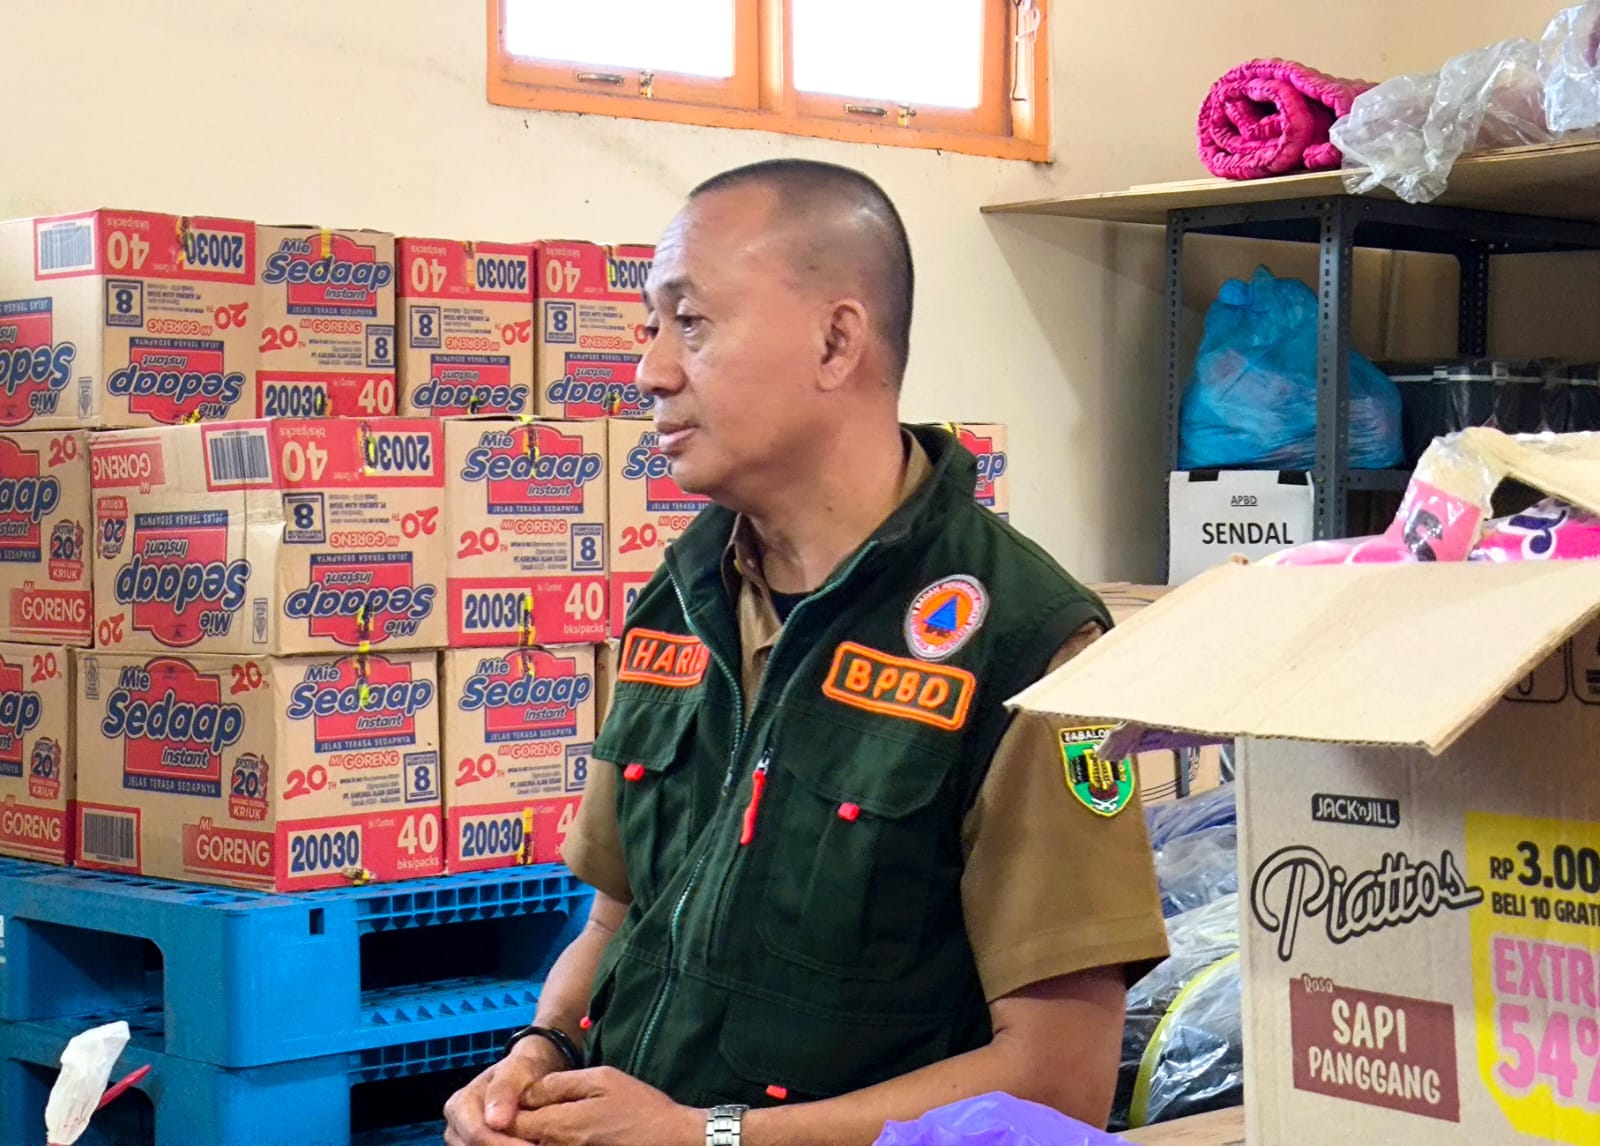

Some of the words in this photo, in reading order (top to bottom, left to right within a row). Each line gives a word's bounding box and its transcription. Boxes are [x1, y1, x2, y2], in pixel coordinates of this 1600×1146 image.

[108, 230, 150, 270] 40
[185, 232, 243, 268] 20030
[280, 239, 311, 256] Mie
[262, 253, 392, 292] Sedaap
[411, 257, 448, 293] 40
[476, 258, 526, 290] 20030
[546, 260, 581, 294] 40
[115, 290, 133, 314] 8
[325, 287, 368, 300] Instant
[147, 318, 200, 335] GORENG
[312, 319, 362, 334] GORENG
[418, 314, 434, 336] 8
[554, 310, 568, 332] 8
[258, 324, 298, 353] 20
[374, 336, 388, 360] 8
[445, 336, 488, 350] GORENG
[580, 336, 622, 350] GORENG
[142, 355, 188, 366] Instant
[106, 362, 245, 404] Sedaap
[441, 370, 479, 381] Instant
[576, 368, 612, 379] Instant
[28, 390, 60, 415] Mie
[264, 384, 326, 417] 20030
[358, 379, 394, 415] 40
[412, 378, 529, 413] Sedaap
[198, 402, 230, 419] Mie
[479, 430, 514, 449] Mie
[639, 430, 660, 448] Mi
[282, 441, 328, 482] 40
[368, 434, 430, 472] 20030
[462, 447, 603, 487] Sedaap
[527, 482, 574, 498] Instant
[1231, 495, 1258, 506] APBD
[293, 503, 314, 530] 8
[514, 519, 568, 535] GORENG
[330, 531, 386, 548] GORENG
[458, 526, 500, 559] 20
[619, 523, 657, 554] 20
[1202, 522, 1294, 544] SENDAL
[144, 538, 189, 558] Instant
[580, 536, 596, 562] 8
[52, 568, 78, 581] KRIUK
[114, 554, 251, 614] Sedaap
[324, 571, 374, 586] Instant
[21, 596, 86, 622] GORENG
[284, 581, 436, 619] Sedaap
[564, 582, 604, 621] 40
[199, 610, 232, 636] Mie
[385, 620, 420, 637] Mie
[120, 666, 151, 690] Mie
[303, 664, 340, 682] Mie
[477, 658, 510, 676] Mie
[459, 674, 592, 710] Sedaap
[844, 658, 950, 709] BPBD
[286, 679, 434, 720] Sedaap
[101, 688, 244, 756] Sedaap
[356, 716, 404, 731] Instant
[524, 708, 568, 720] Instant
[320, 741, 344, 751] JELAS
[345, 738, 373, 750] TERASA
[490, 732, 512, 742] JELAS
[513, 730, 539, 740] TERASA
[540, 728, 572, 738] SEDAPNYA
[1063, 728, 1106, 742] TABALO
[161, 746, 210, 769] Instant
[343, 750, 399, 770] GORENG
[511, 742, 562, 759] GORENG
[414, 766, 430, 792] 8
[455, 754, 496, 786] 20
[573, 756, 588, 781] 8
[128, 775, 148, 787] JELAS
[150, 778, 175, 790] TERASA
[178, 781, 216, 794] SEDAPNYA
[283, 764, 328, 800] 20
[234, 805, 262, 819] KRIUK
[2, 811, 60, 841] GORENG
[397, 812, 440, 854] 40
[462, 817, 523, 858] 20030
[196, 834, 270, 867] GORENG
[291, 830, 360, 873] 20030
[1490, 856, 1514, 880] RP
[1250, 844, 1485, 962] Piattos
[1492, 892, 1526, 917] BELI
[1530, 896, 1551, 920] 10
[1302, 973, 1334, 994] Rasa
[1494, 938, 1600, 1009] EXTR
[1332, 998, 1407, 1054] SAPI
[1308, 1046, 1441, 1104] PANGGANG
